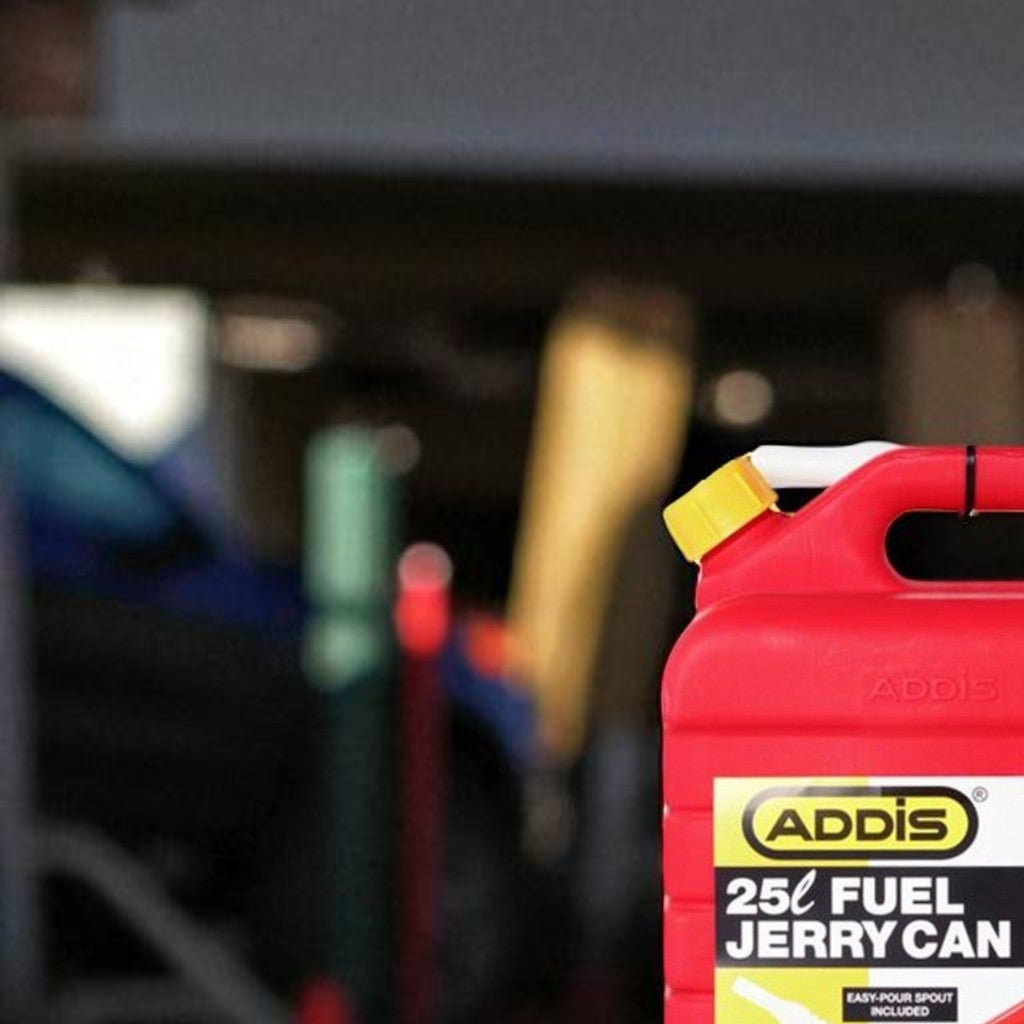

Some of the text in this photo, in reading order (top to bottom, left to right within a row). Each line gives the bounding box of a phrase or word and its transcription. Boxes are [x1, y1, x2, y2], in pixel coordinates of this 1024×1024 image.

[831, 877, 964, 915] FUEL
[725, 919, 1011, 959] JERRY CAN
[846, 991, 954, 1004] EASY-POUR SPOUT
[870, 1006, 930, 1018] INCLUDED
